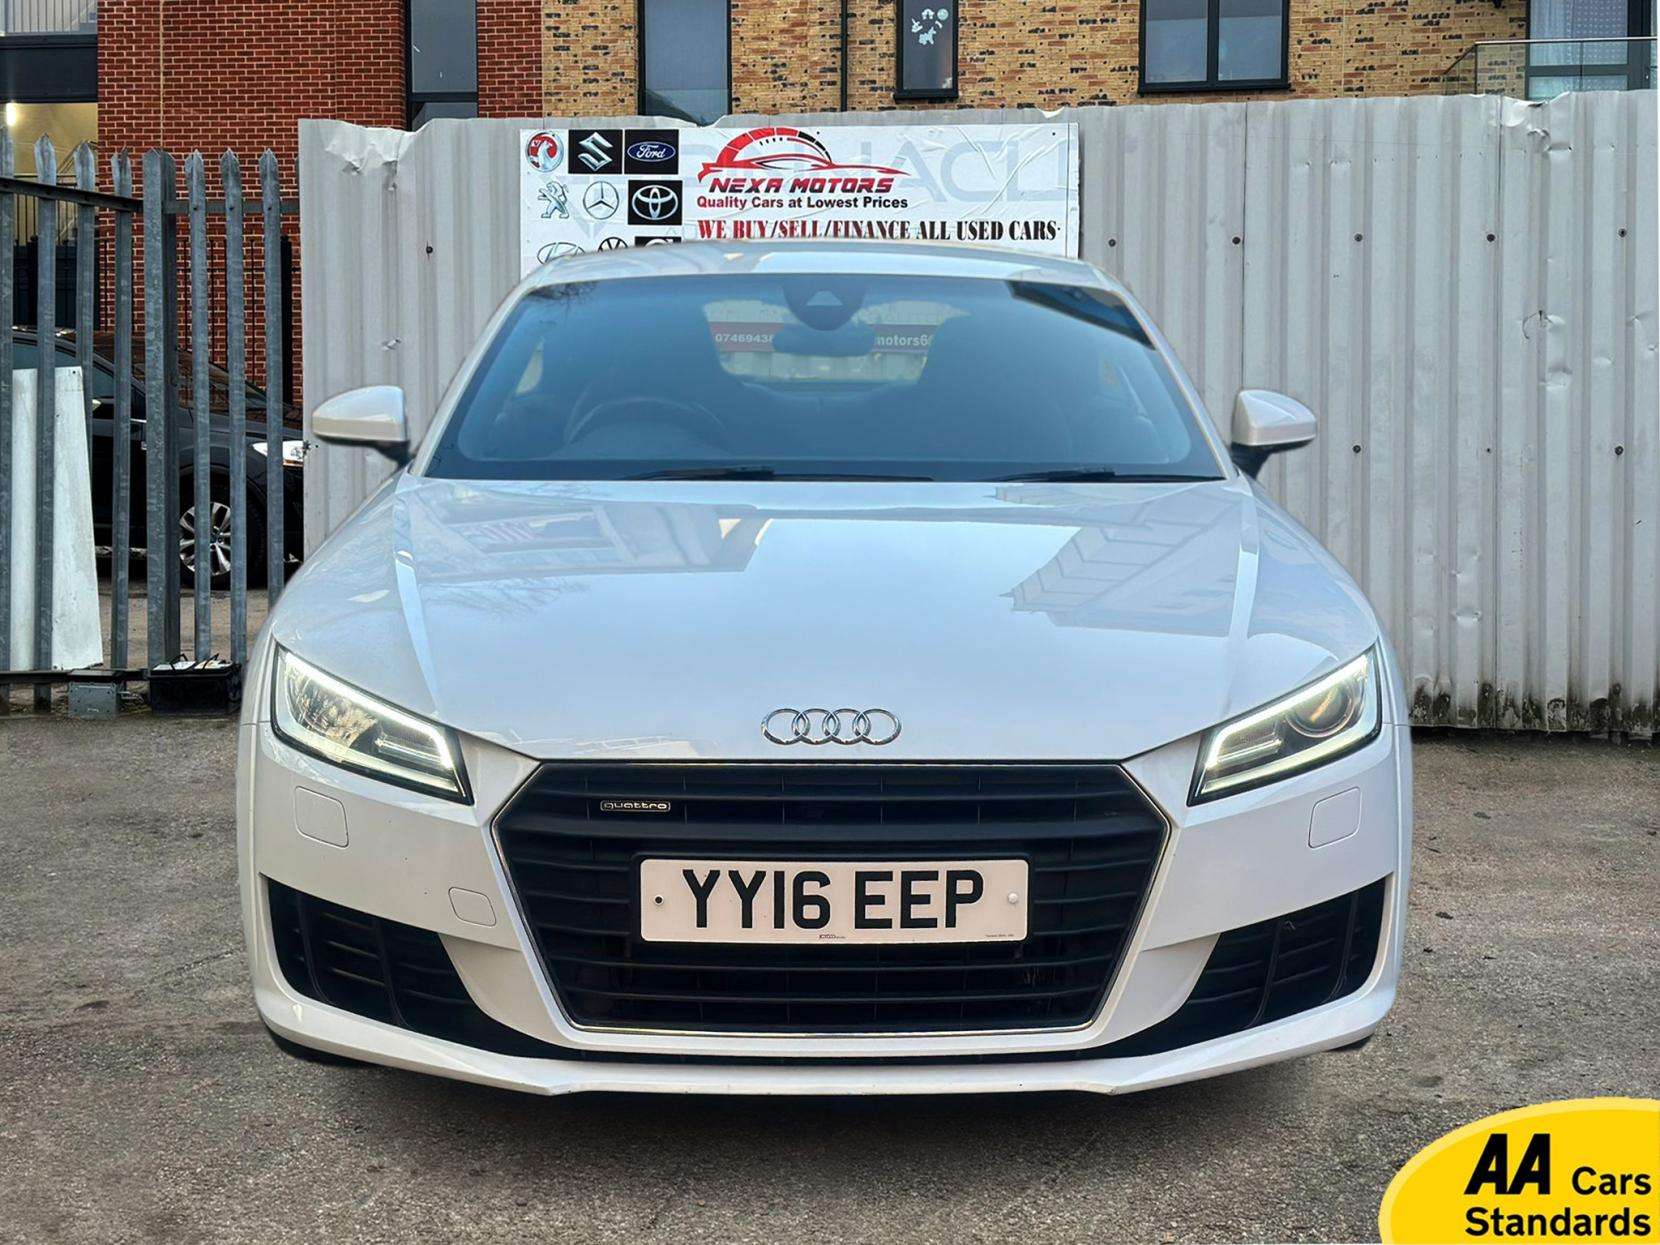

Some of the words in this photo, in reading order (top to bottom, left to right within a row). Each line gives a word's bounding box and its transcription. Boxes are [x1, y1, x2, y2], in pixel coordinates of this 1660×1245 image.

[636, 144, 666, 158] Ford
[709, 178, 782, 193] NEXA
[790, 178, 894, 193] MOTORS
[697, 195, 747, 210] Quality
[751, 196, 784, 208] Cars
[788, 197, 802, 208] at
[807, 196, 858, 208] Lowest
[863, 196, 908, 208] Prices
[697, 219, 726, 239] WE
[917, 220, 952, 240] ALL
[956, 220, 1003, 241] USED
[682, 869, 831, 929] YY16
[854, 870, 984, 929] EEP
